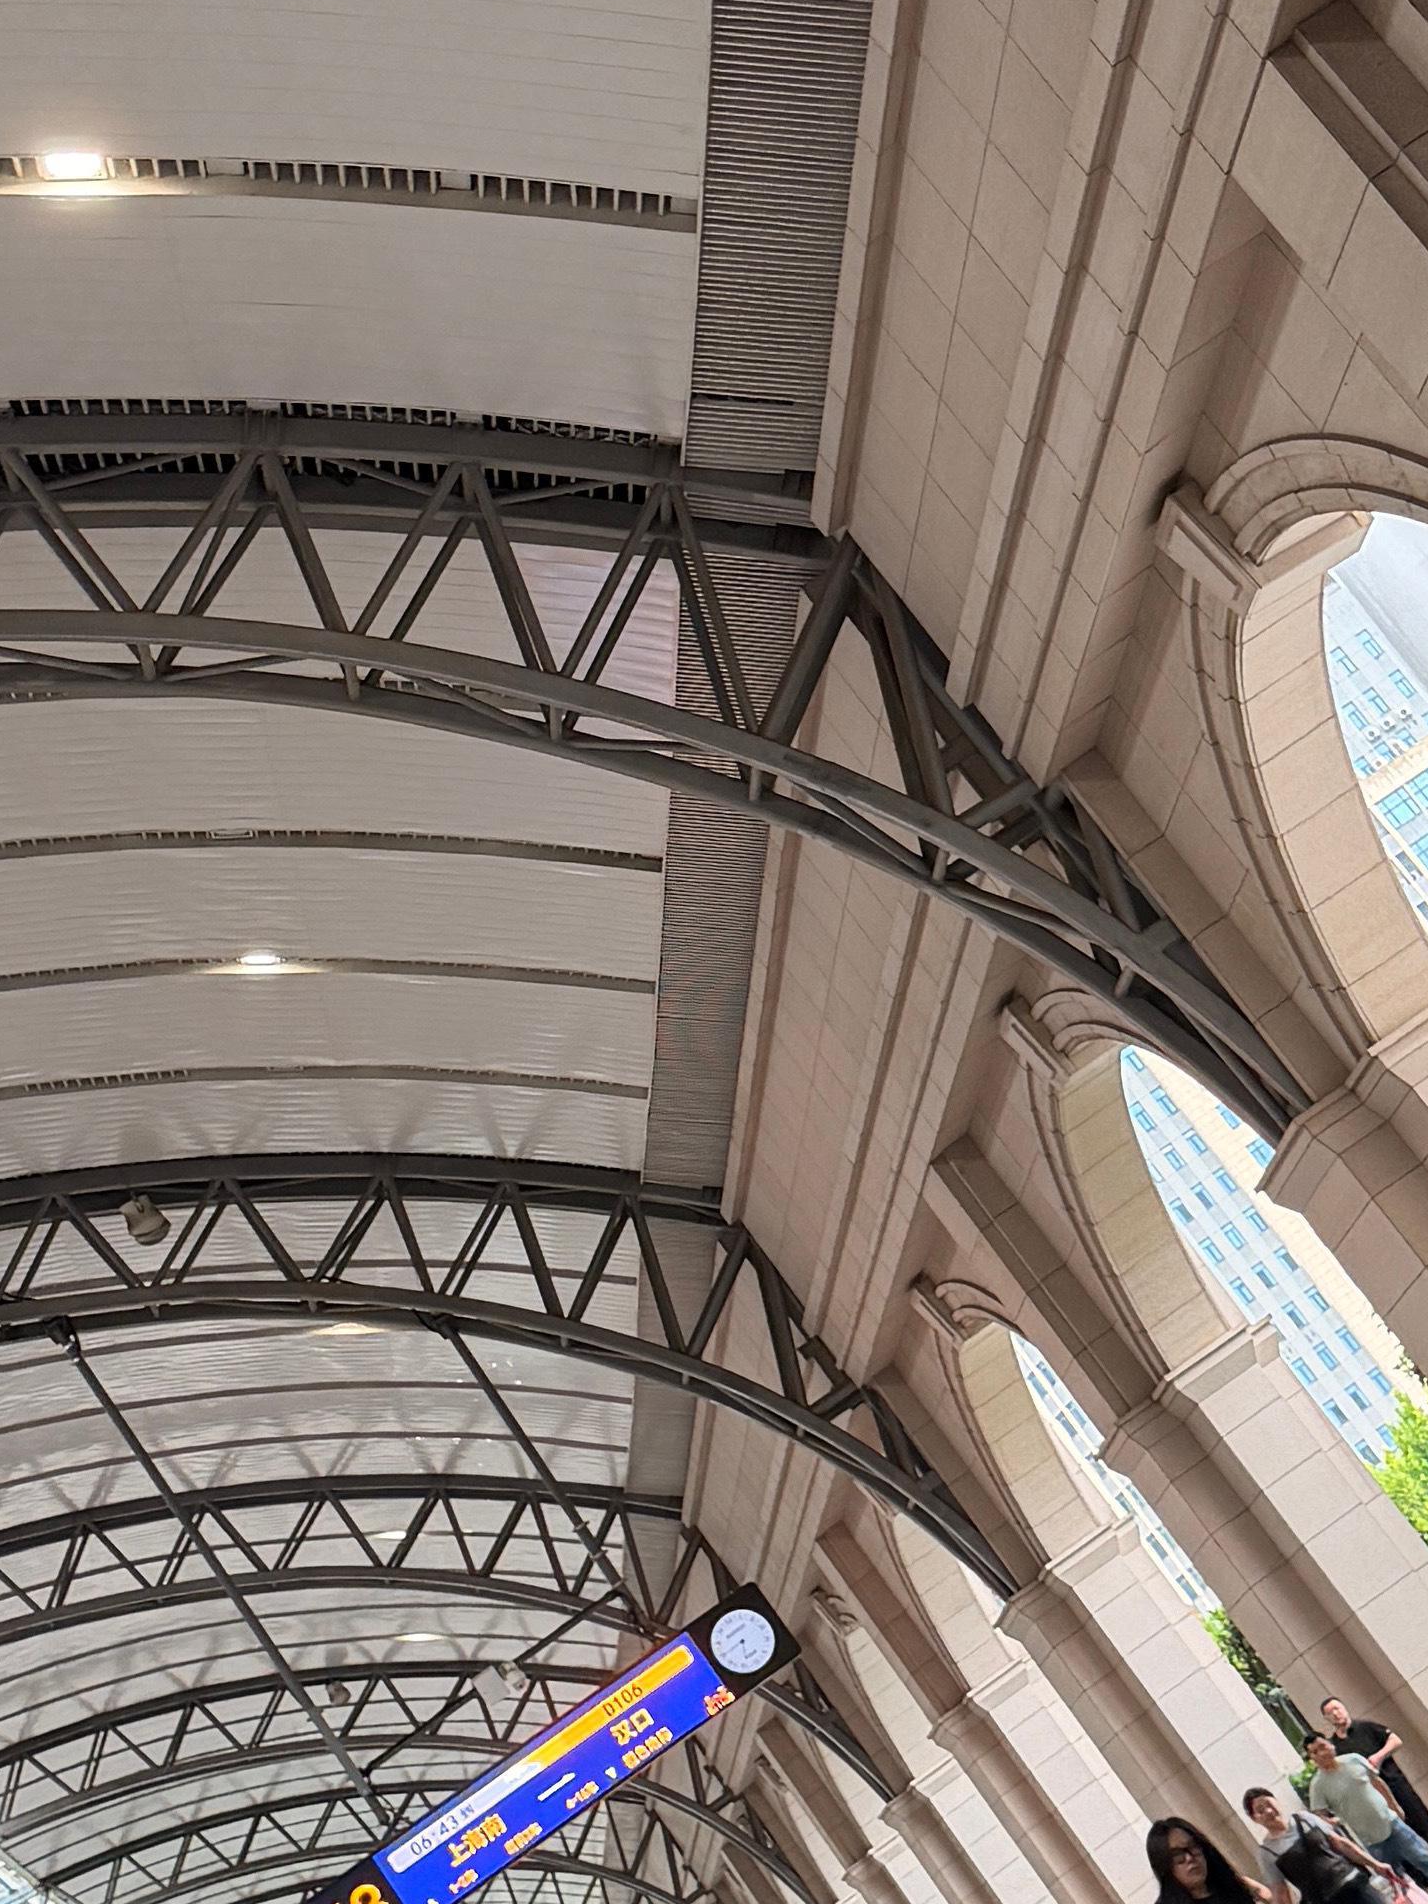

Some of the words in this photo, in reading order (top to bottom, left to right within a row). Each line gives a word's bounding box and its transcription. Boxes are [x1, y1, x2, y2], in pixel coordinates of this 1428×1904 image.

[602, 1683, 643, 1717] D106
[610, 1708, 654, 1746] 汉口
[410, 1814, 460, 1856] 06:43
[448, 1815, 507, 1867] 上海南
